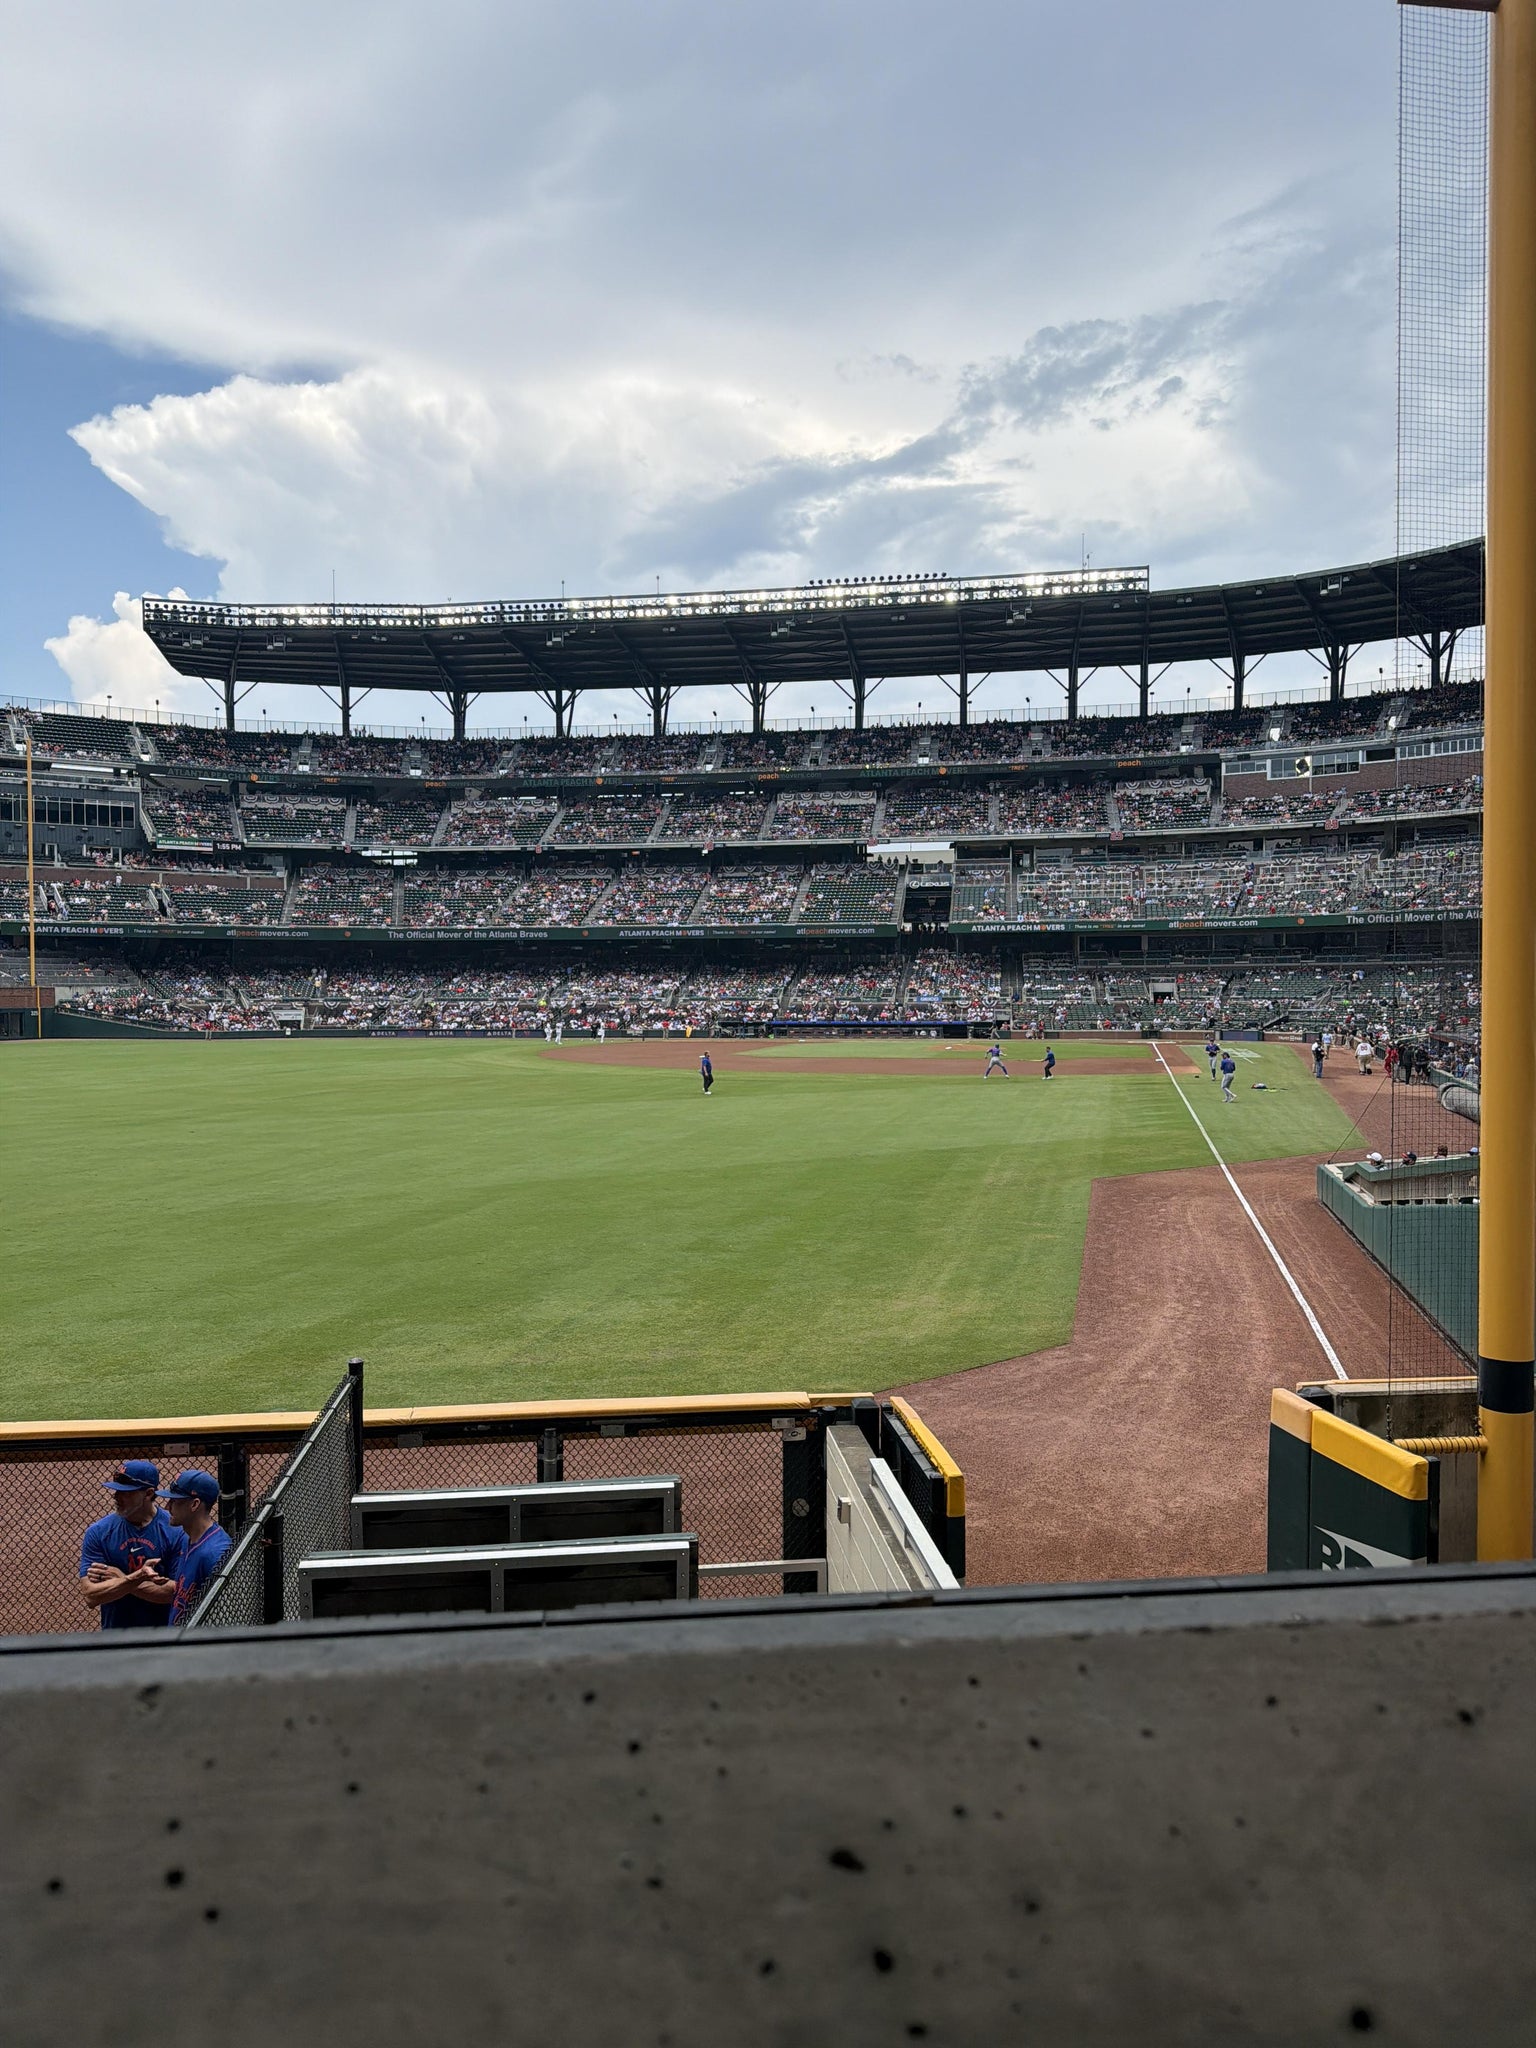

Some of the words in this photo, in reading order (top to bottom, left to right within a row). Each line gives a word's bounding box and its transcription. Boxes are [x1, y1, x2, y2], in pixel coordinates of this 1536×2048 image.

[231, 843, 242, 851] PM
[1346, 915, 1364, 924] The
[1367, 914, 1401, 923] Official
[1404, 913, 1434, 922] Mover
[1437, 911, 1447, 921] of
[1449, 911, 1463, 920] the
[1168, 919, 1258, 929] atlpeachmovers.com
[20, 926, 60, 934] ATLANTA
[226, 930, 309, 938] atlpeachmovers.com
[796, 927, 875, 936] atlpeachmovers.com
[388, 931, 404, 939] The
[406, 931, 435, 939] Official
[437, 931, 462, 939] Mover
[464, 931, 472, 939] of
